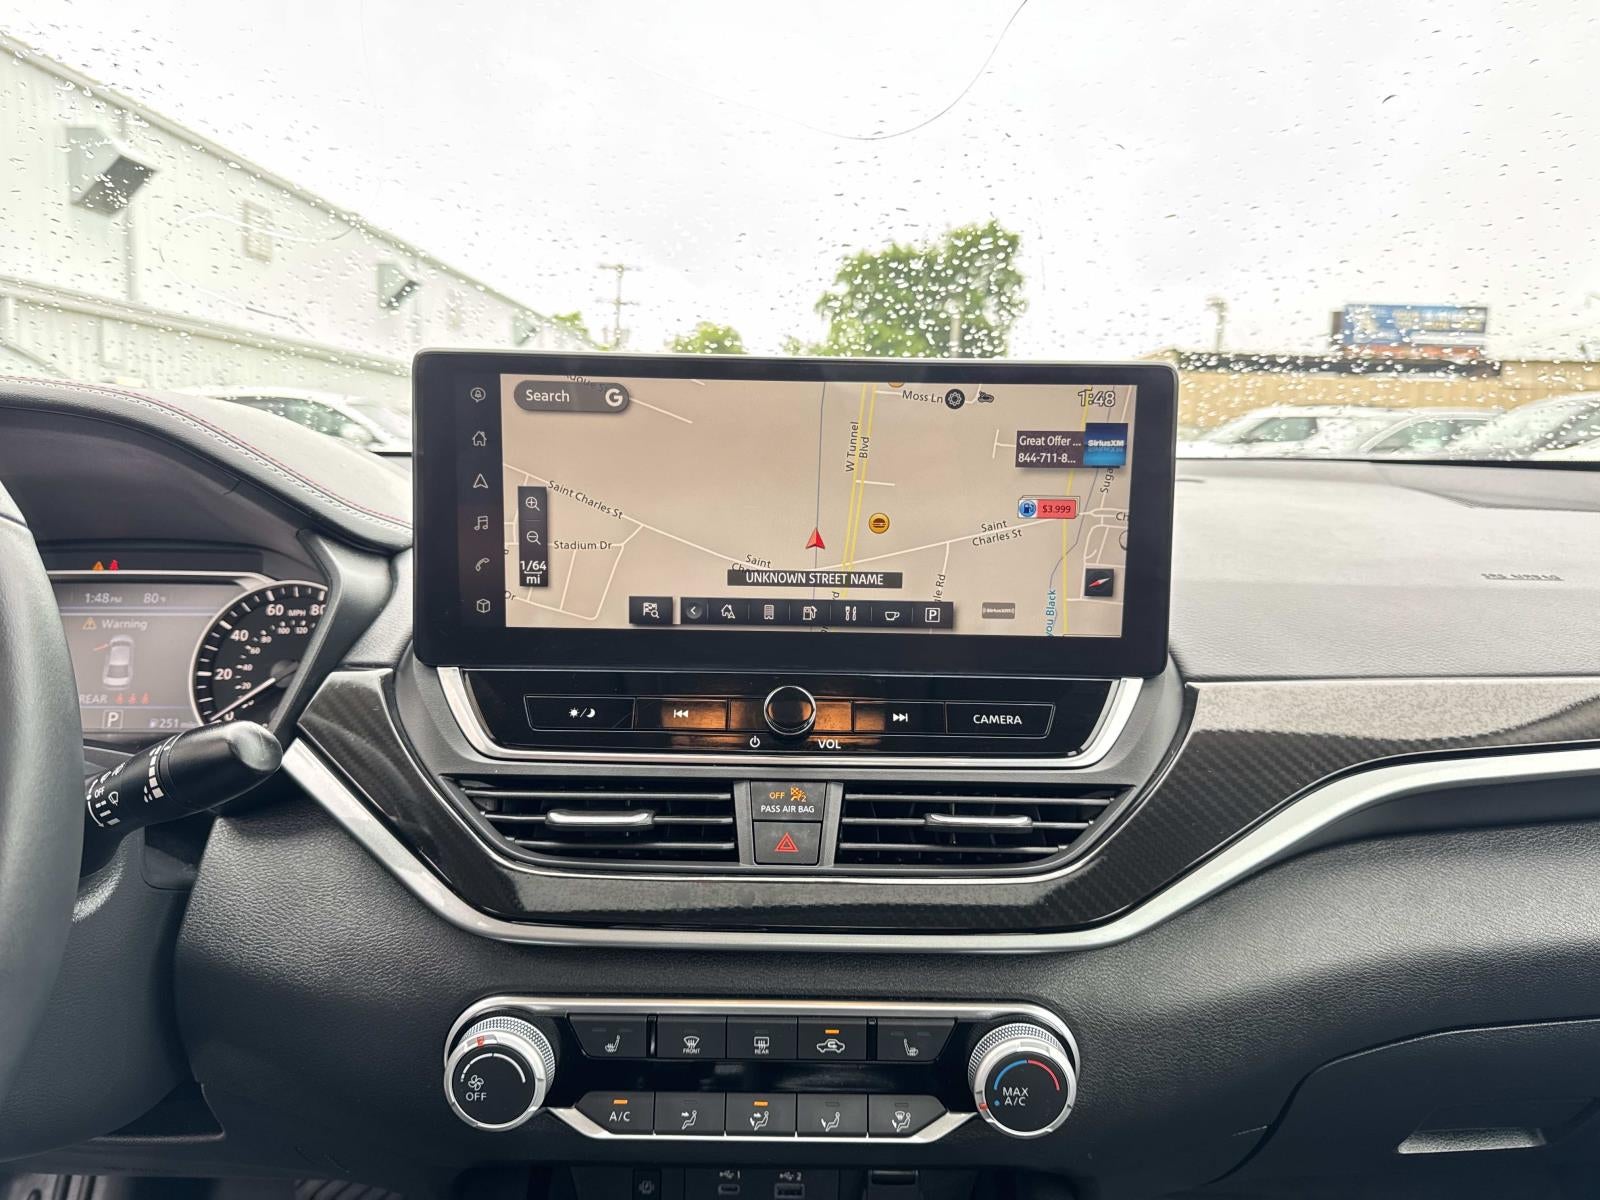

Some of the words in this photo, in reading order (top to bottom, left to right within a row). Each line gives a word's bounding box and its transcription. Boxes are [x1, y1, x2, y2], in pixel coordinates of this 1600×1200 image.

[526, 389, 570, 402] Search
[902, 390, 928, 402] Moss
[931, 395, 943, 403] Ln
[1078, 390, 1116, 407] 1:48
[847, 421, 859, 458] Tunnel
[1019, 435, 1045, 447] Great
[1047, 435, 1071, 447] Offer
[859, 436, 870, 459] Blvd
[846, 460, 855, 472] W
[548, 480, 573, 498] Saint
[575, 492, 613, 514] Charles
[612, 508, 623, 519] St
[981, 520, 1007, 533] Saint
[972, 533, 1010, 546] Charles
[1012, 528, 1023, 538] St
[553, 540, 597, 550] Stadium
[600, 541, 613, 550] Dr
[520, 560, 547, 571] 1/64
[745, 554, 771, 568] Saint
[526, 575, 541, 584] mi
[745, 571, 806, 584] UNKNOWN
[809, 573, 847, 585] STREET
[850, 573, 884, 585] NAME
[935, 574, 946, 587] Rd
[1045, 589, 1056, 616] Black
[266, 604, 284, 616] 60
[288, 609, 306, 617] MPH
[102, 619, 148, 631] Warning
[230, 629, 249, 641] 40
[214, 668, 233, 680] 20
[79, 694, 108, 703] REAR
[108, 711, 119, 728] P
[973, 714, 1023, 725] CAMERA
[817, 738, 841, 749] VOL
[94, 786, 106, 799] OFF
[769, 791, 785, 800] OFF
[760, 804, 781, 813] PASS
[782, 805, 797, 813] AIR
[798, 805, 815, 813] BAG
[465, 1091, 488, 1102] OFF
[1002, 1086, 1029, 1097] MAX
[1004, 1096, 1026, 1107] A/C
[608, 1110, 631, 1122] A/C
